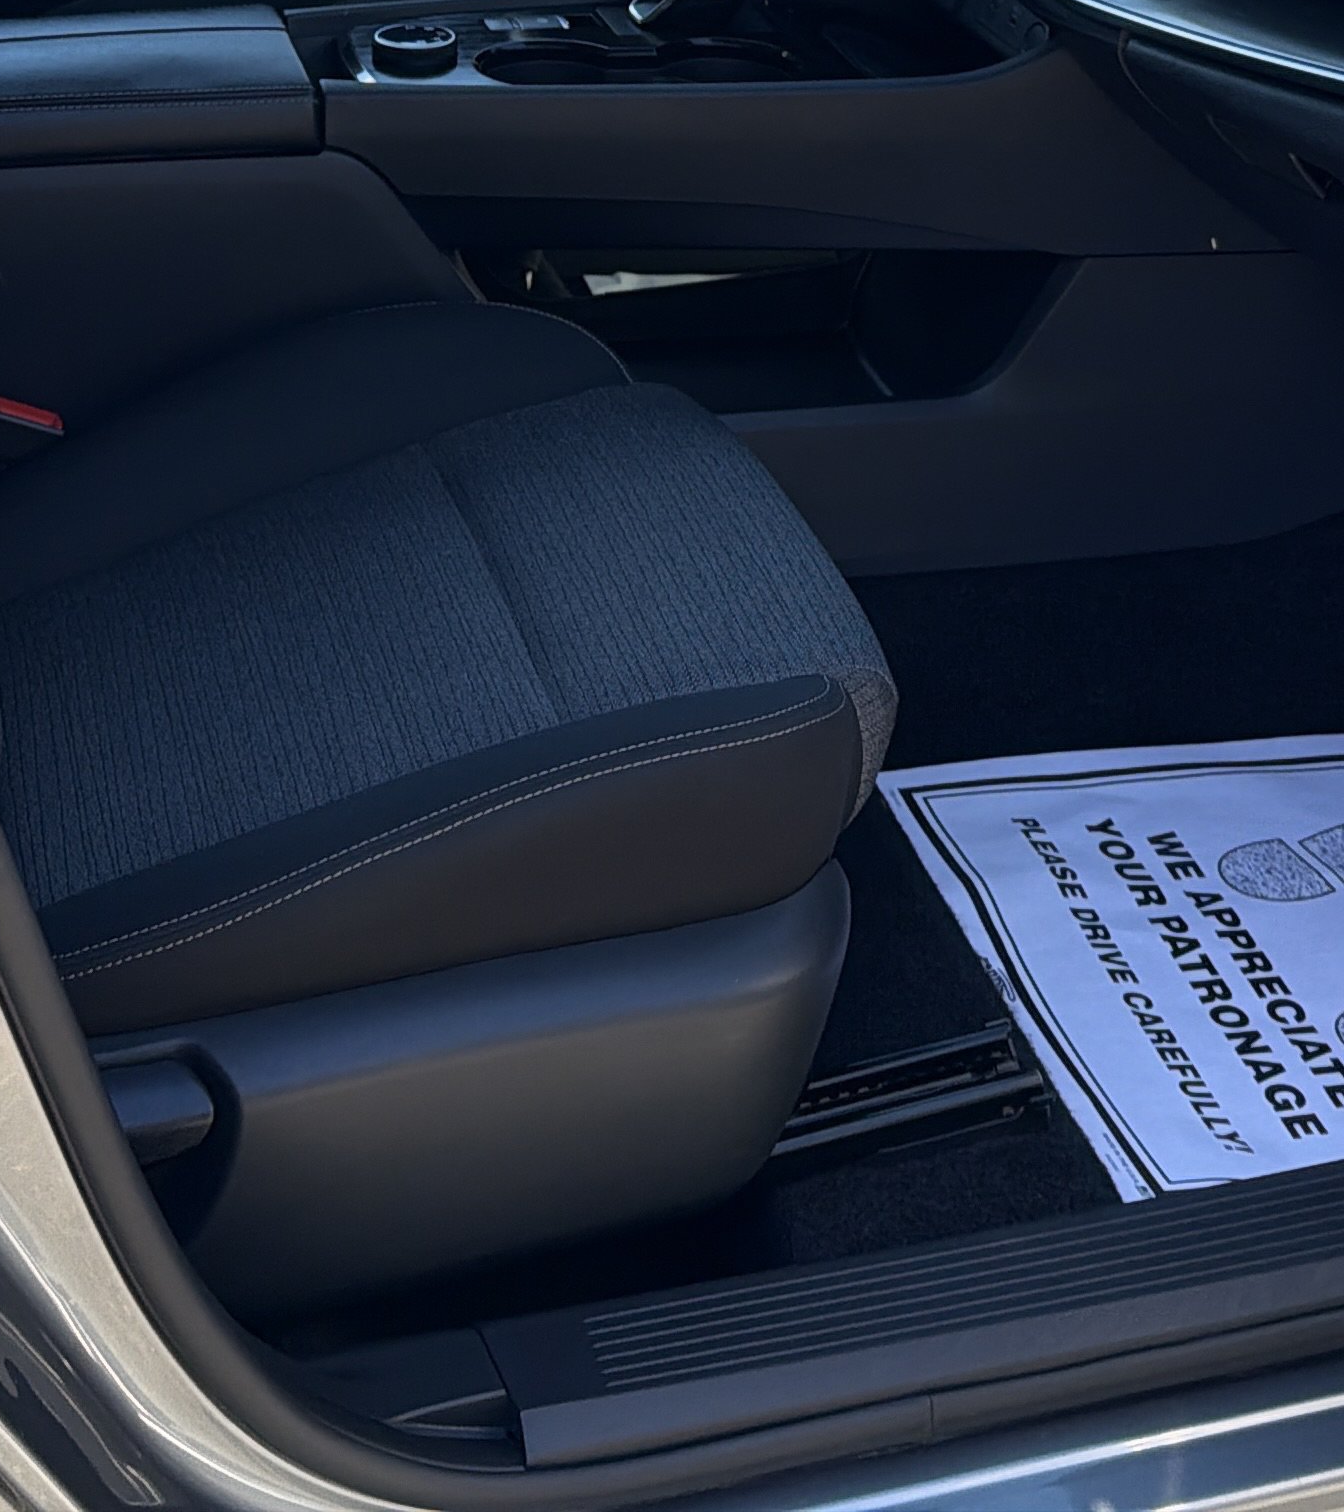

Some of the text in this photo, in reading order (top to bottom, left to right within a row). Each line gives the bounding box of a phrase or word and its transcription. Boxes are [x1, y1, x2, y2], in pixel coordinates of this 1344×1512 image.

[1010, 816, 1089, 900] PLEASE
[1068, 906, 1140, 985] DRIVE
[1122, 992, 1257, 1156] CAREFULLY!
[1084, 817, 1329, 1140] YOUR PATRONAGE
[1146, 830, 1206, 881] WE
